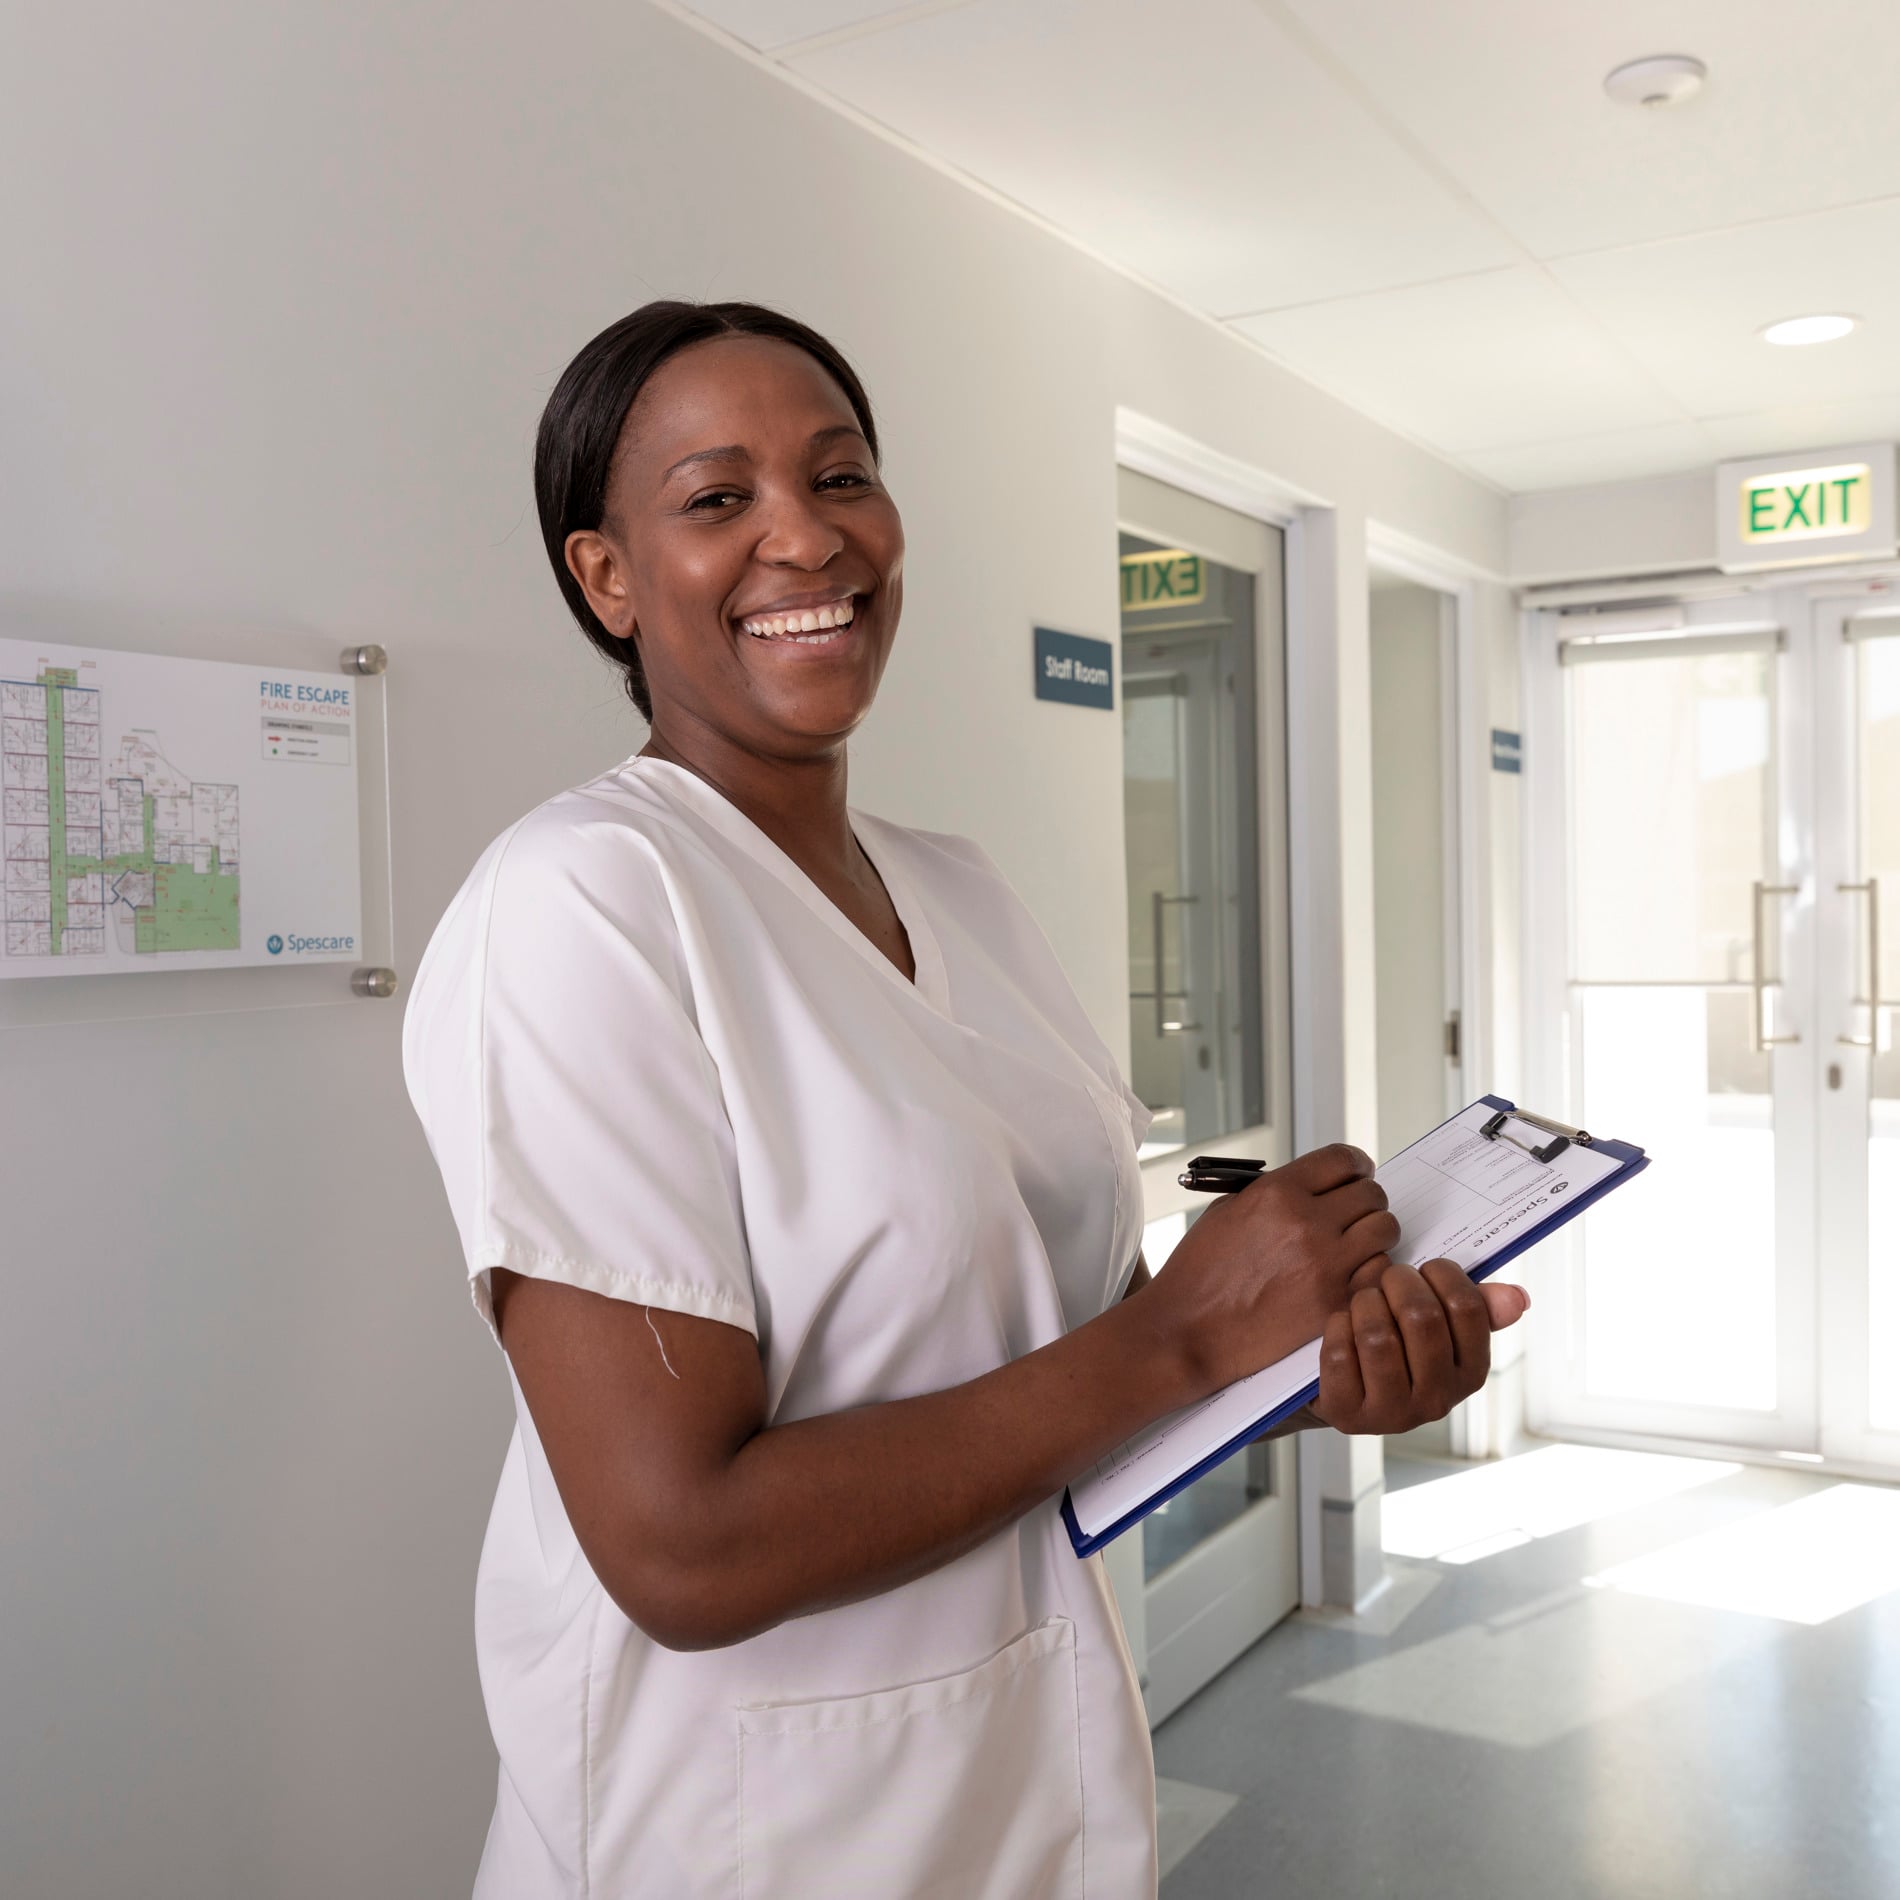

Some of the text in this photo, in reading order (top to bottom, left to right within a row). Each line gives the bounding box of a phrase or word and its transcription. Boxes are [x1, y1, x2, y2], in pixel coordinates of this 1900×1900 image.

[1750, 477, 1860, 532] EXIT
[1045, 655, 1109, 686] Staff Room
[260, 681, 350, 705] FIRE ESCAPE
[260, 699, 351, 717] PLAN OF ACTION
[288, 934, 354, 954] Spescare
[1472, 1196, 1549, 1248] Spescare
